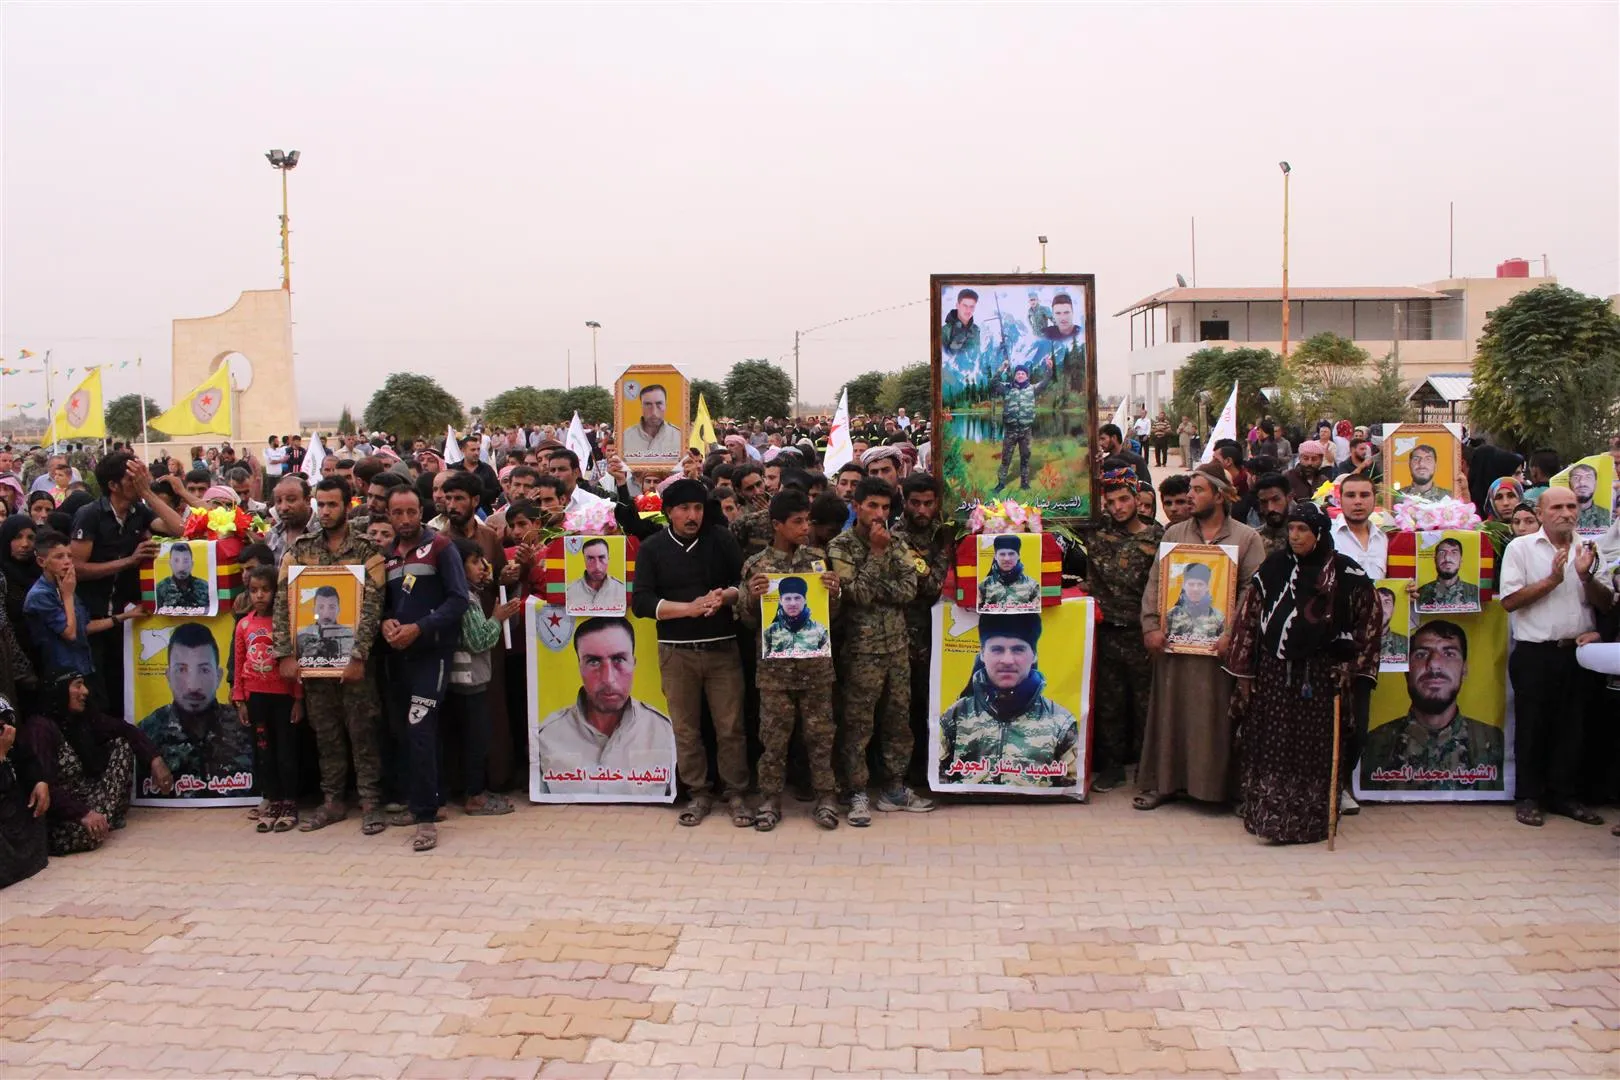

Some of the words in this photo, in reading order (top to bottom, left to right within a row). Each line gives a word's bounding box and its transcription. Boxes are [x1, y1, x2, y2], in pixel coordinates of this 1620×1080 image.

[1051, 496, 1081, 510] الشهيد
[543, 768, 587, 781] المحمد
[588, 767, 623, 781] خلف
[946, 758, 990, 776] الجوهر
[991, 760, 1022, 776] بشار
[1025, 760, 1068, 778] الشهيد
[1371, 765, 1413, 781] المحمد
[1413, 767, 1451, 781] محمد
[1452, 764, 1497, 784] الشهيد
[207, 771, 252, 795] الشهيد
[627, 767, 671, 785] الشهيد
[175, 774, 207, 797] حاتم
